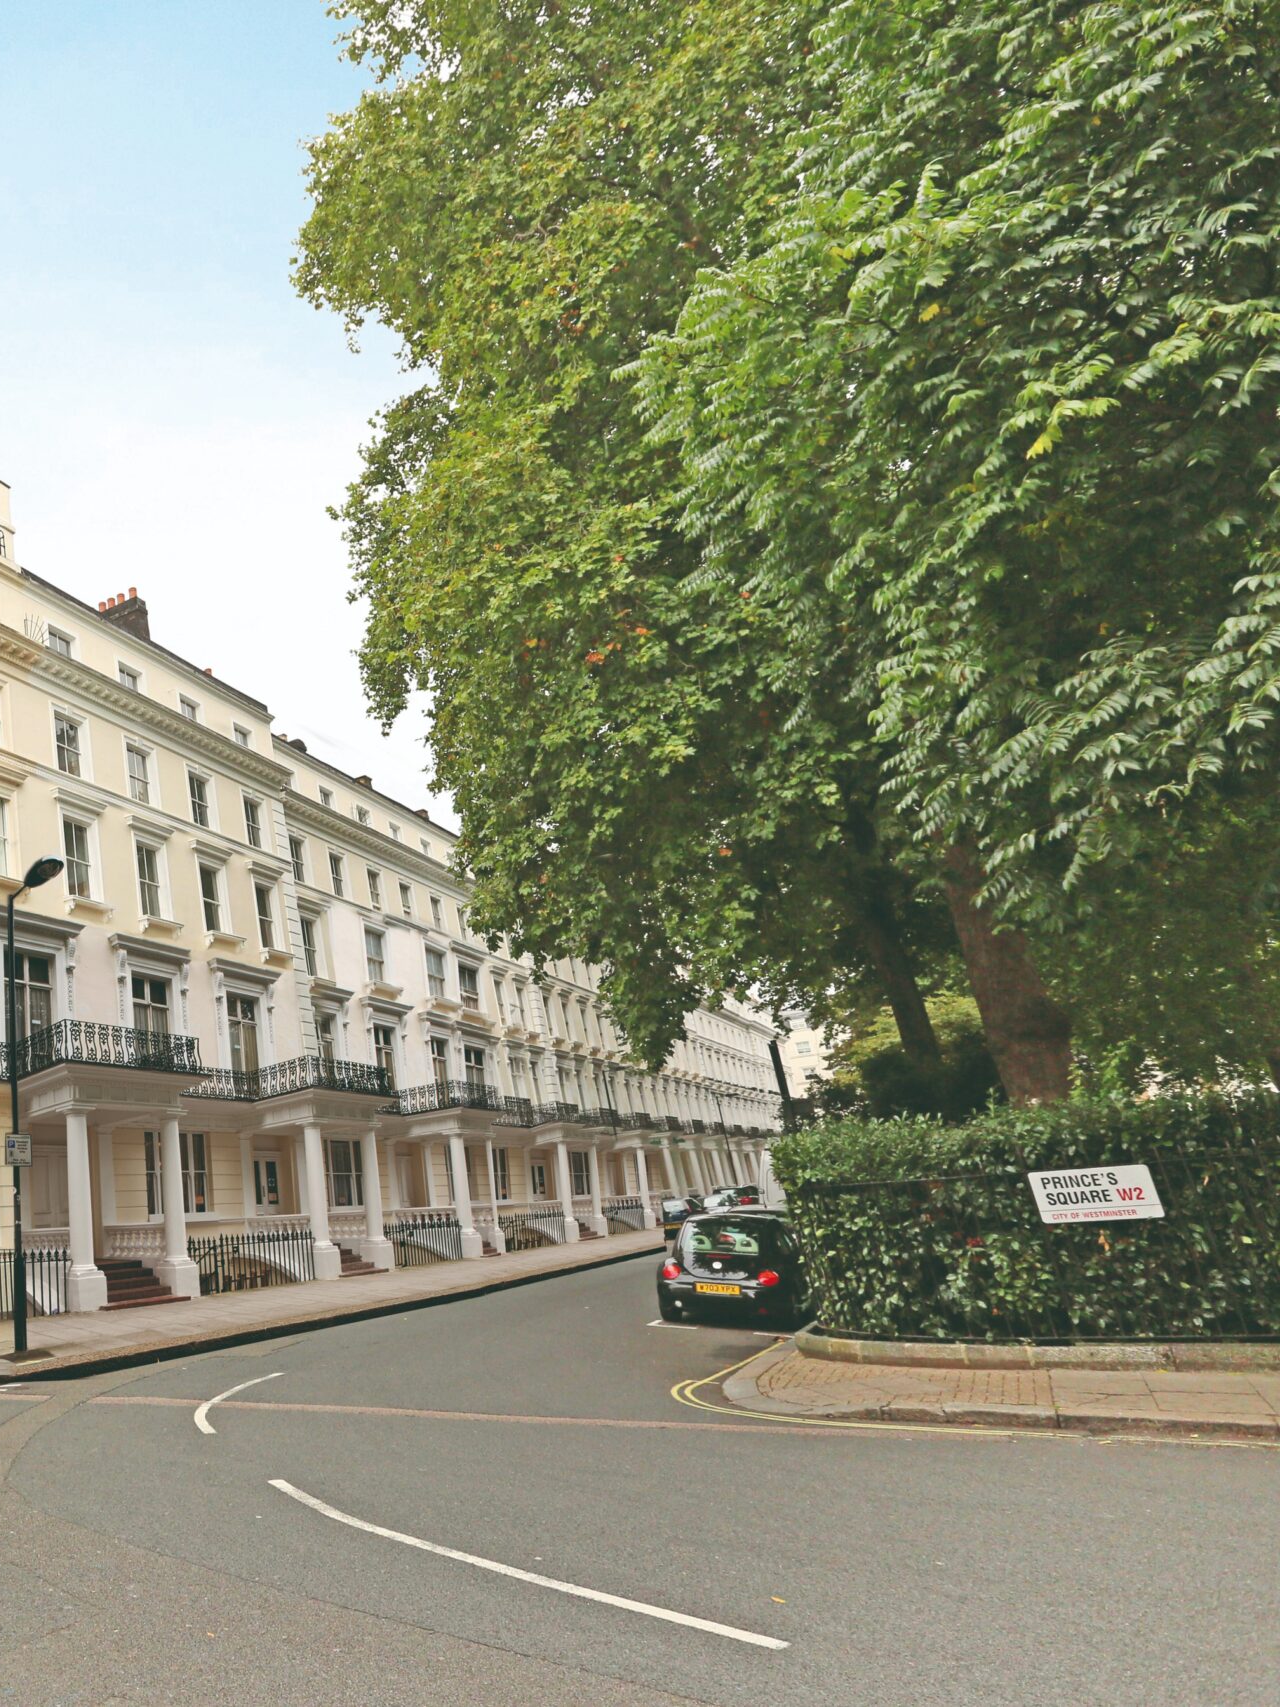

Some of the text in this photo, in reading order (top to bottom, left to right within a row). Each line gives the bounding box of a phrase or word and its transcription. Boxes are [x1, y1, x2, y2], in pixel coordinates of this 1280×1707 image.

[1040, 1172, 1118, 1190] PRINCE'S
[1045, 1187, 1145, 1206] SQUARE W2
[1083, 1208, 1138, 1218] WESTMINSTER
